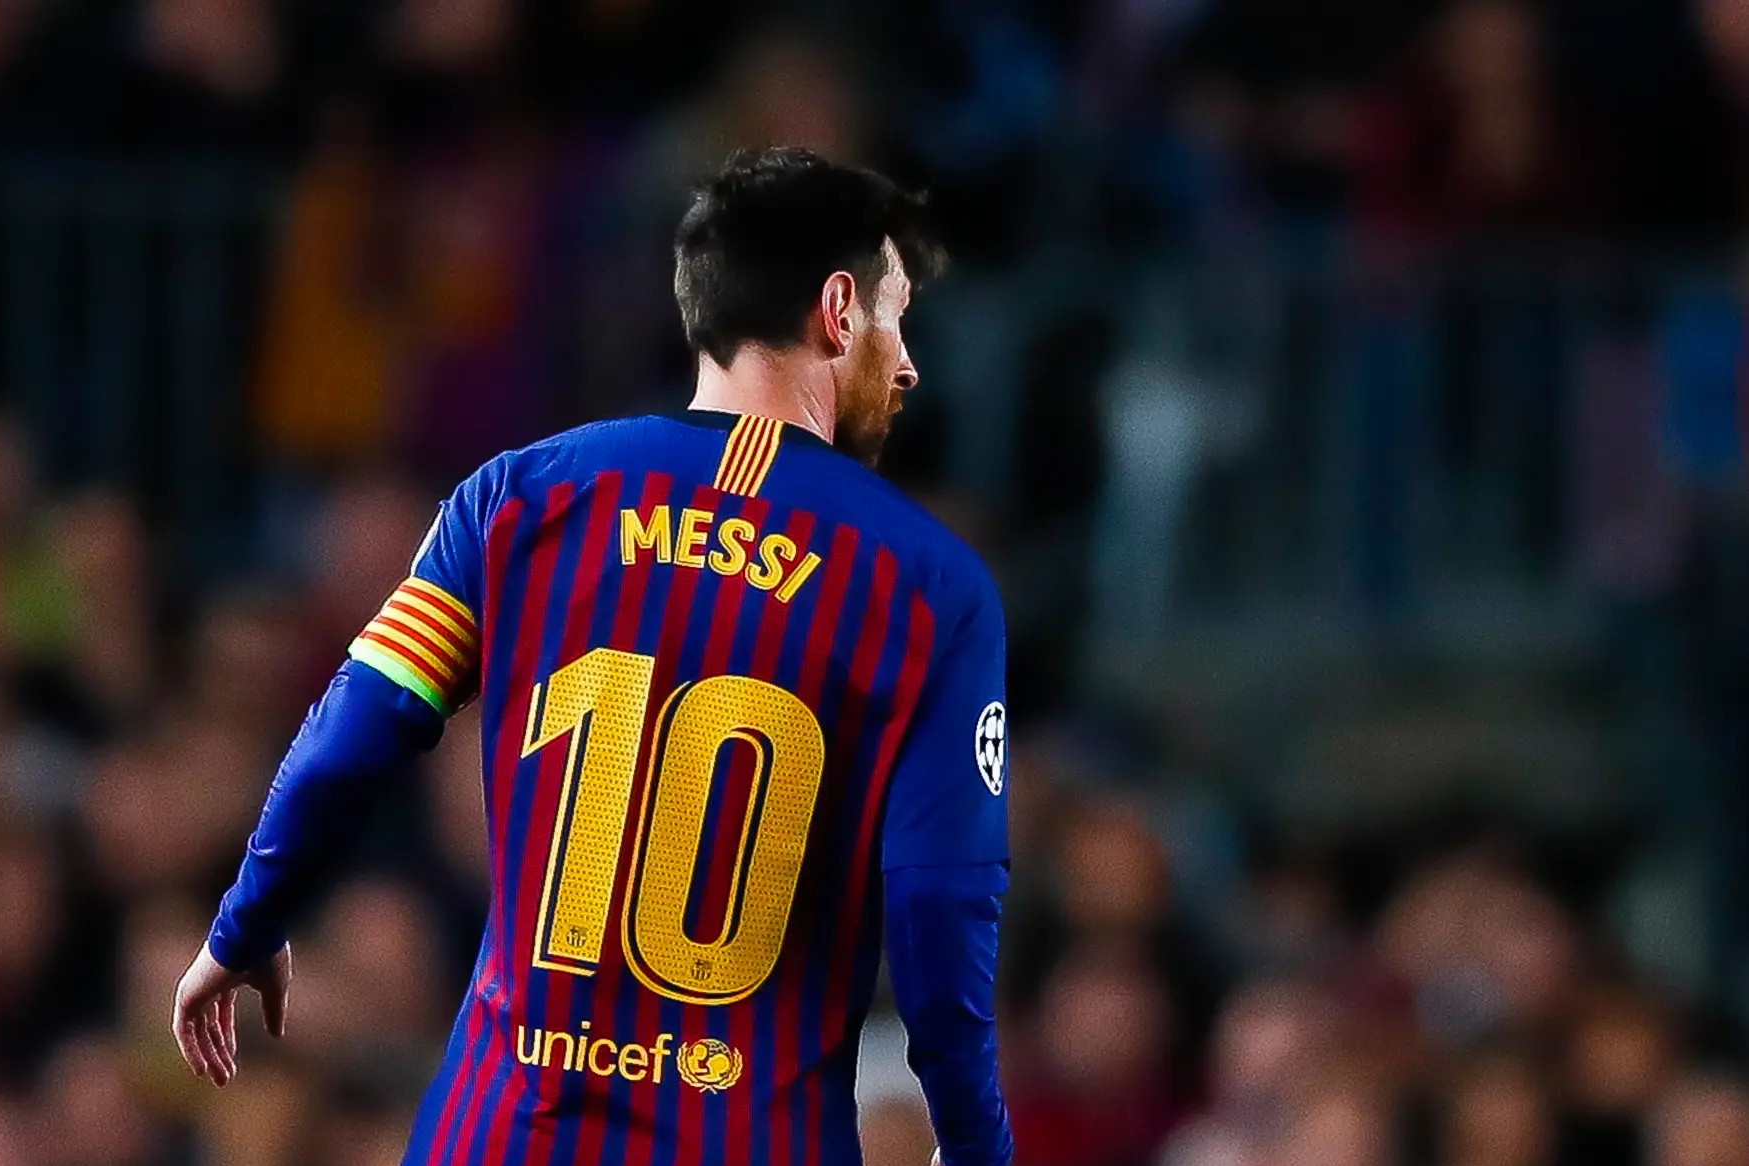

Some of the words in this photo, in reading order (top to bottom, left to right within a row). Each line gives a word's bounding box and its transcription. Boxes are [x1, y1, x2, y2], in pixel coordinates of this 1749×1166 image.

[620, 504, 823, 604] MESSI
[520, 647, 826, 1006] 10
[516, 1020, 674, 1085] unicef
